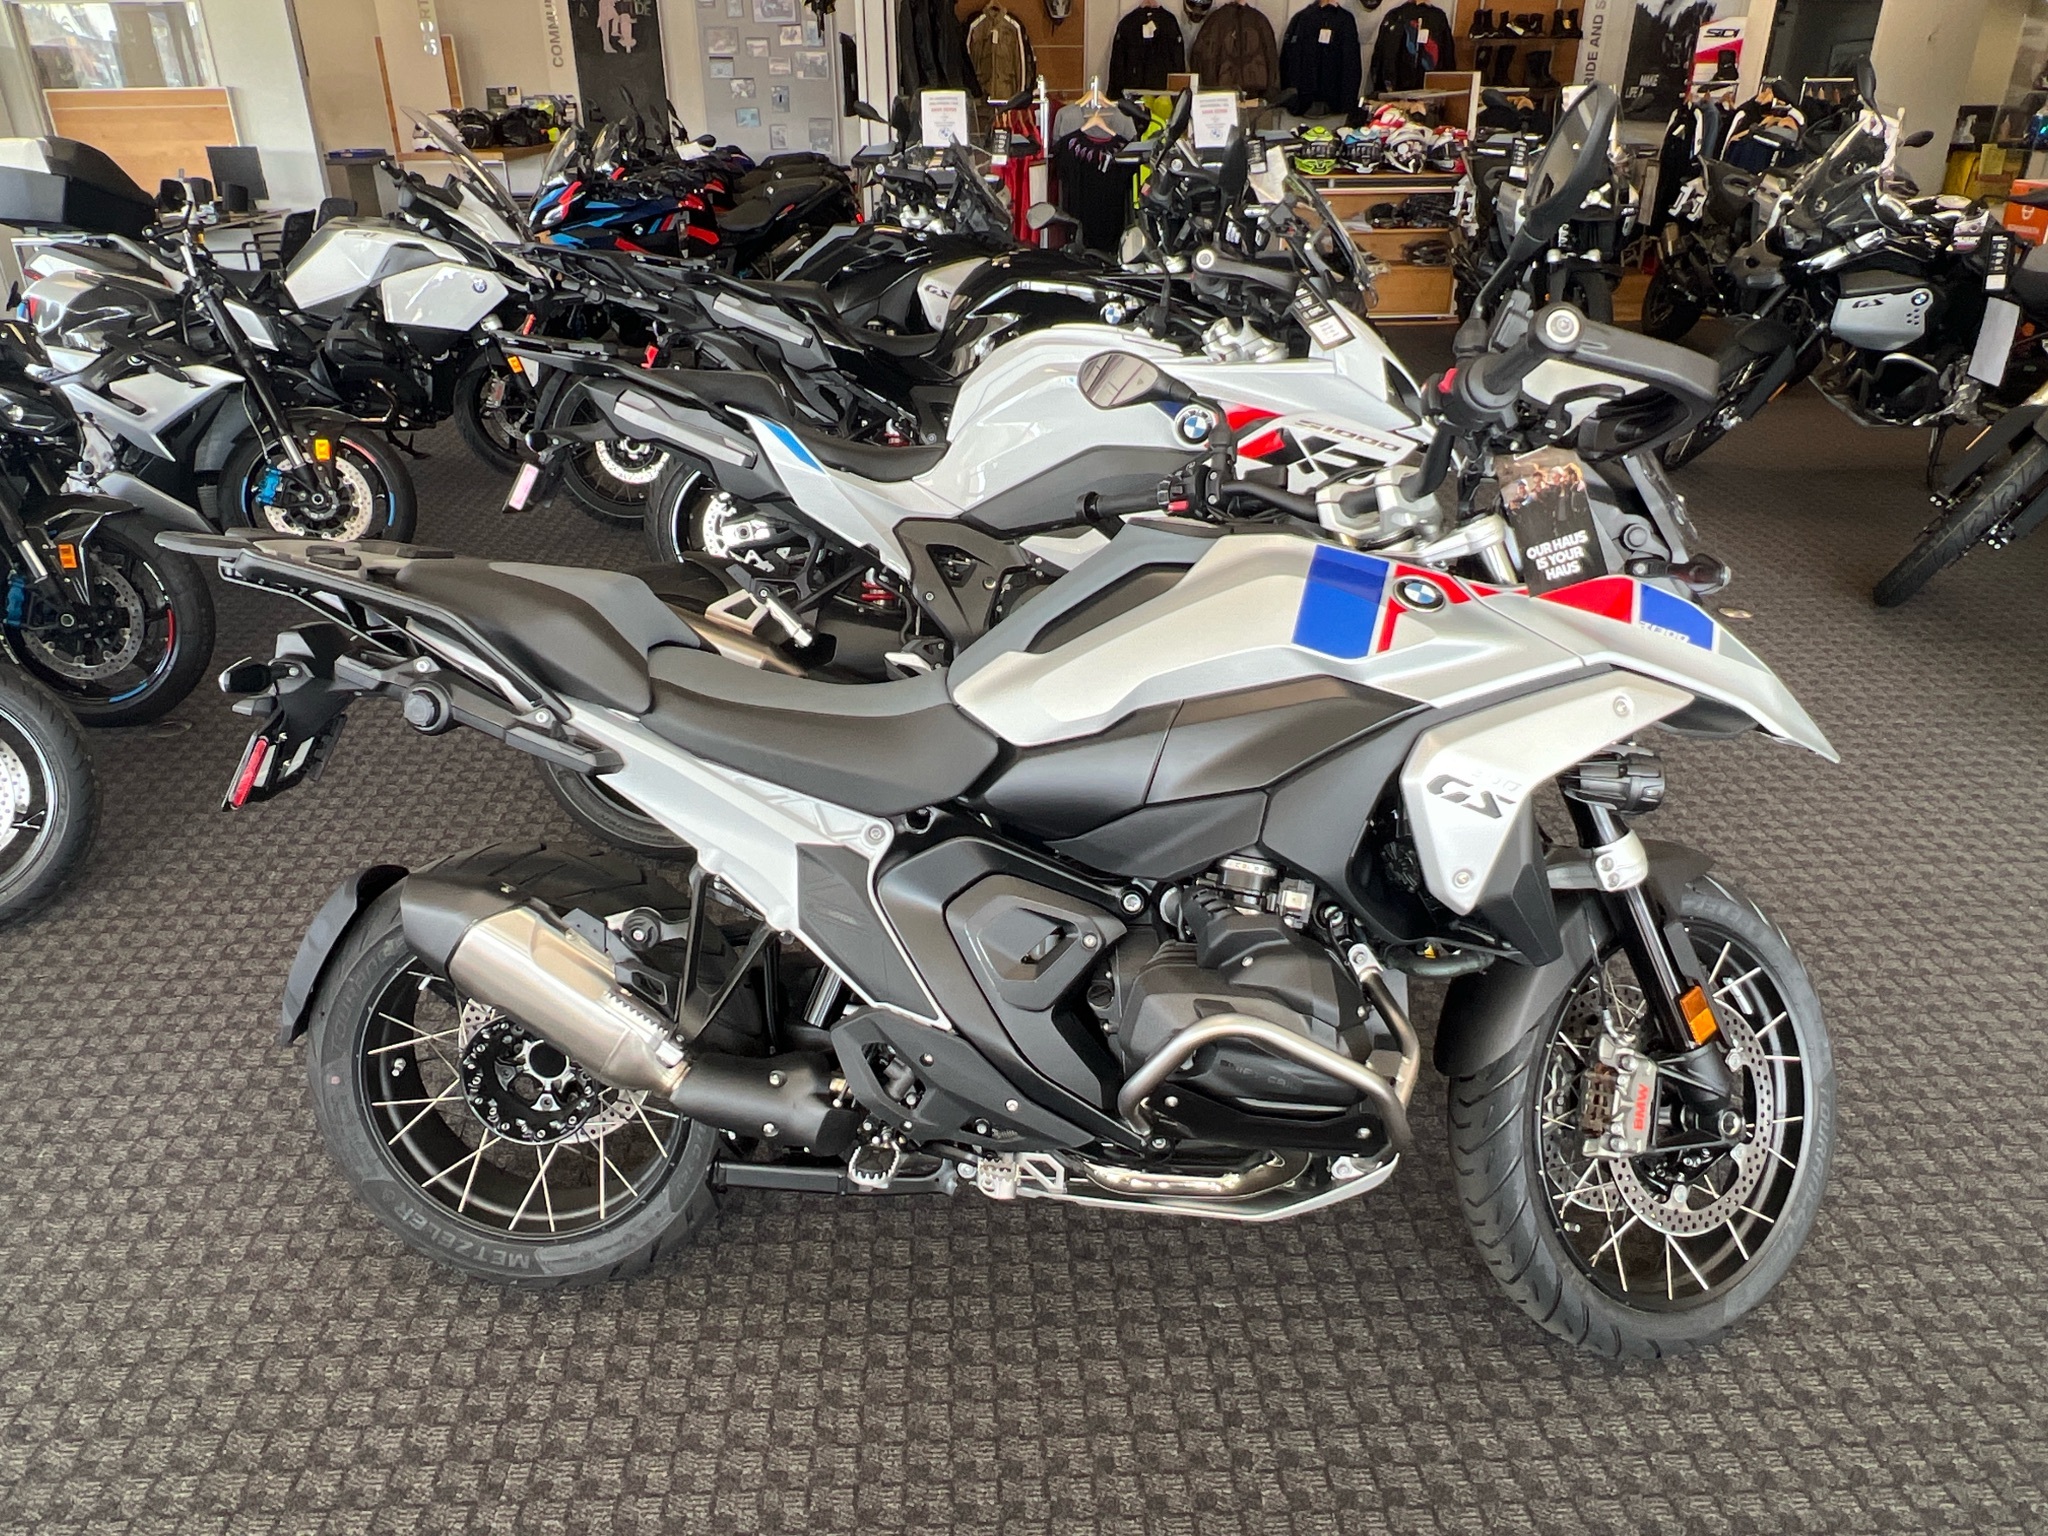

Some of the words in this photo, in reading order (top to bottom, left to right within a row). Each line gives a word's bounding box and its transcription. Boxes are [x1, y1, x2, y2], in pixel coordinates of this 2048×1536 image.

[544, 0, 564, 68] COMMU
[1590, 14, 1604, 48] AND
[1584, 51, 1598, 85] RIDE
[1639, 74, 1660, 87] MAKE
[1295, 419, 1403, 452] S1000
[1526, 542, 1553, 560] OUR
[1552, 529, 1589, 551] HAUS
[1535, 557, 1549, 571] IS
[1547, 545, 1584, 566] YOUR
[1545, 560, 1581, 581] HAUS
[1632, 1083, 1650, 1131] BMW
[394, 1201, 530, 1270] METZELER
